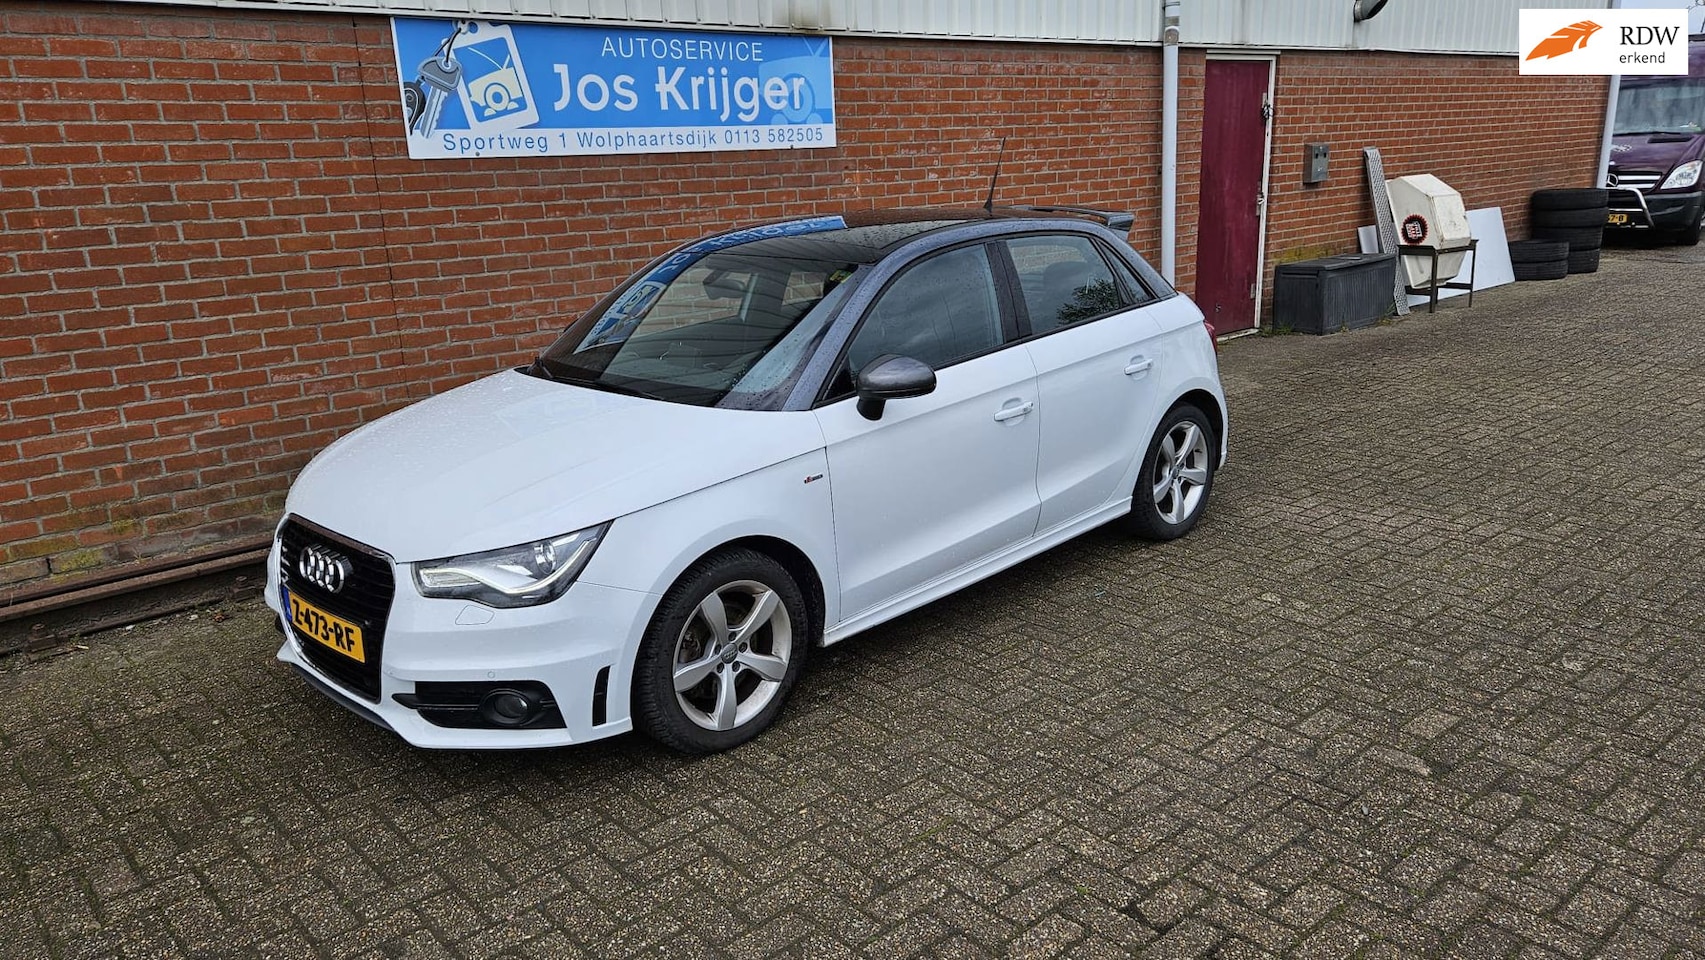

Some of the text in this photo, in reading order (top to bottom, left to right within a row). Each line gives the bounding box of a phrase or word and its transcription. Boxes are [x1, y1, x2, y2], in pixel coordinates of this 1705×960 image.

[601, 37, 763, 62] AUTOSERVICE
[553, 63, 805, 122] Jos Krijger
[443, 127, 824, 154] Sportweg 1 Wolphaartsdijk 0113 582505
[292, 598, 356, 652] Z-473-RF
